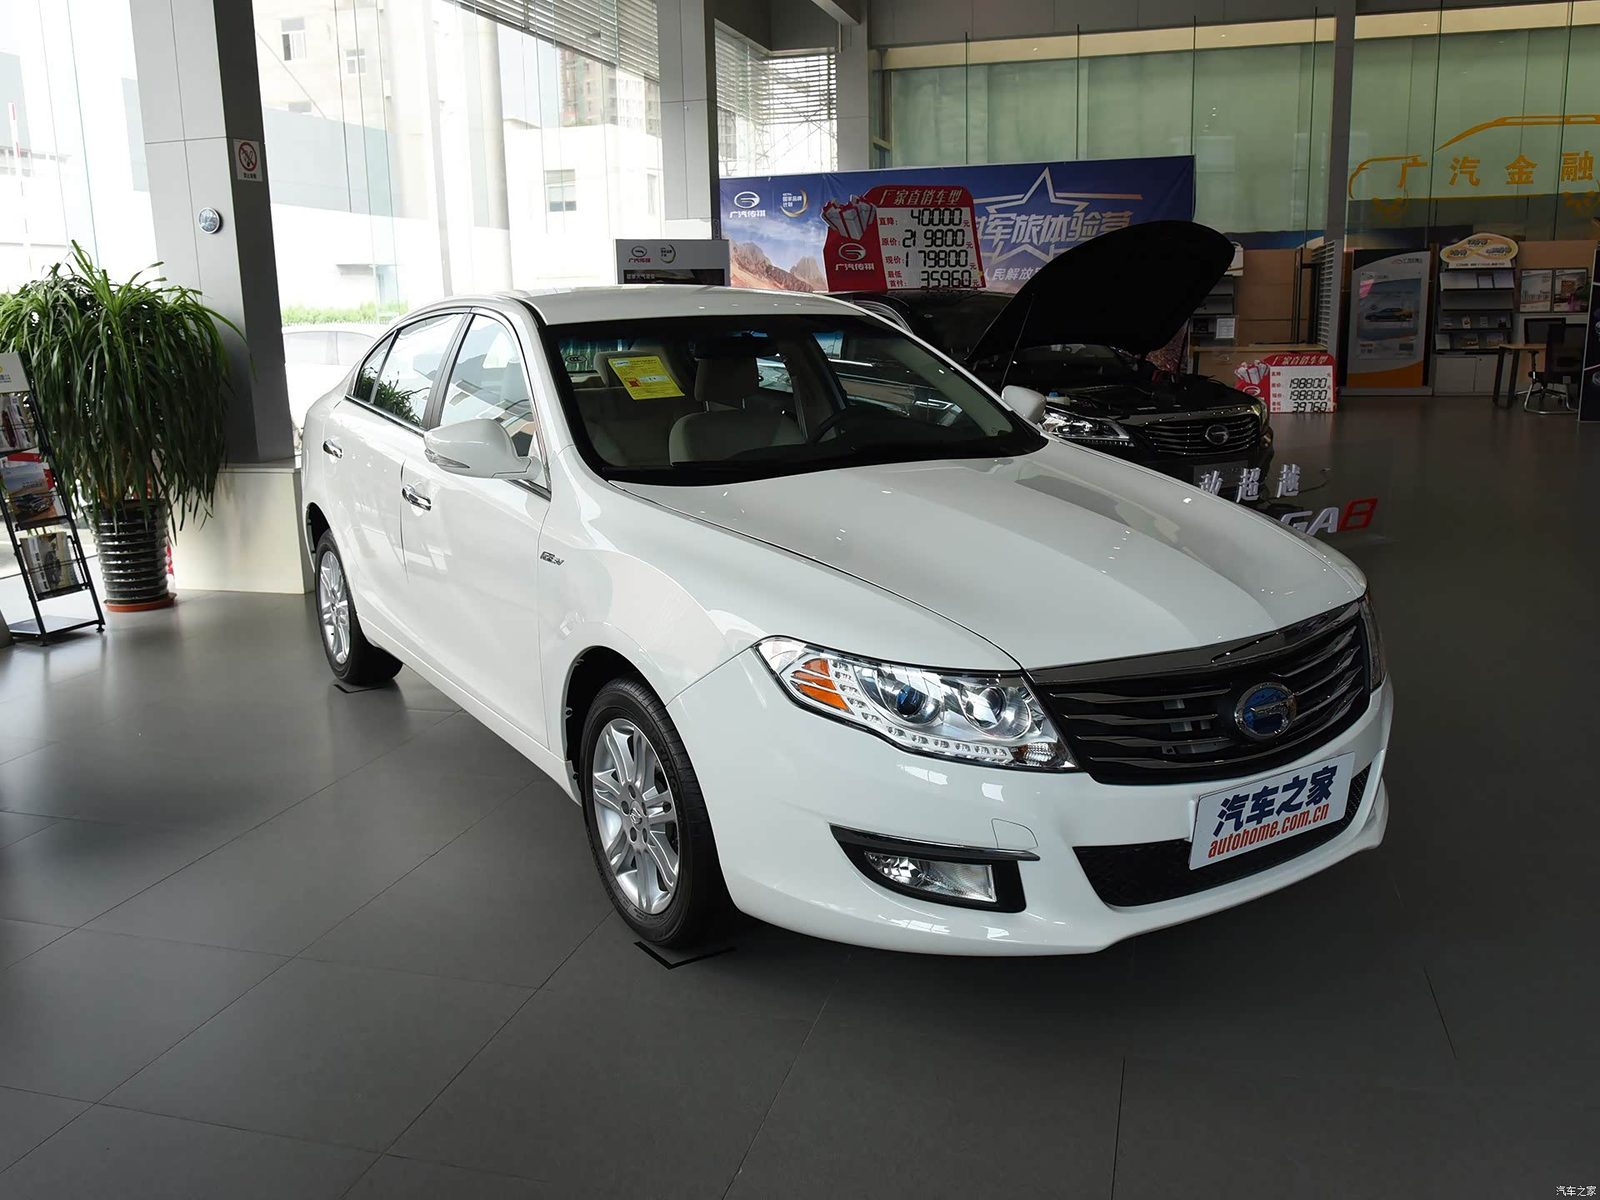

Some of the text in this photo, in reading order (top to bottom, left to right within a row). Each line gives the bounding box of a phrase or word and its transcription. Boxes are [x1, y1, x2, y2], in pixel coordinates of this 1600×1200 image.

[1397, 151, 1594, 188] 广汽金融
[879, 189, 962, 205] 厂家直销车型
[910, 208, 962, 226] 40000
[921, 270, 972, 288] 35960
[984, 267, 1041, 281] 人民解放
[1289, 389, 1328, 401] 198800
[1213, 765, 1338, 837] 汽车之家
[1208, 803, 1329, 859] autohome.com.cn
